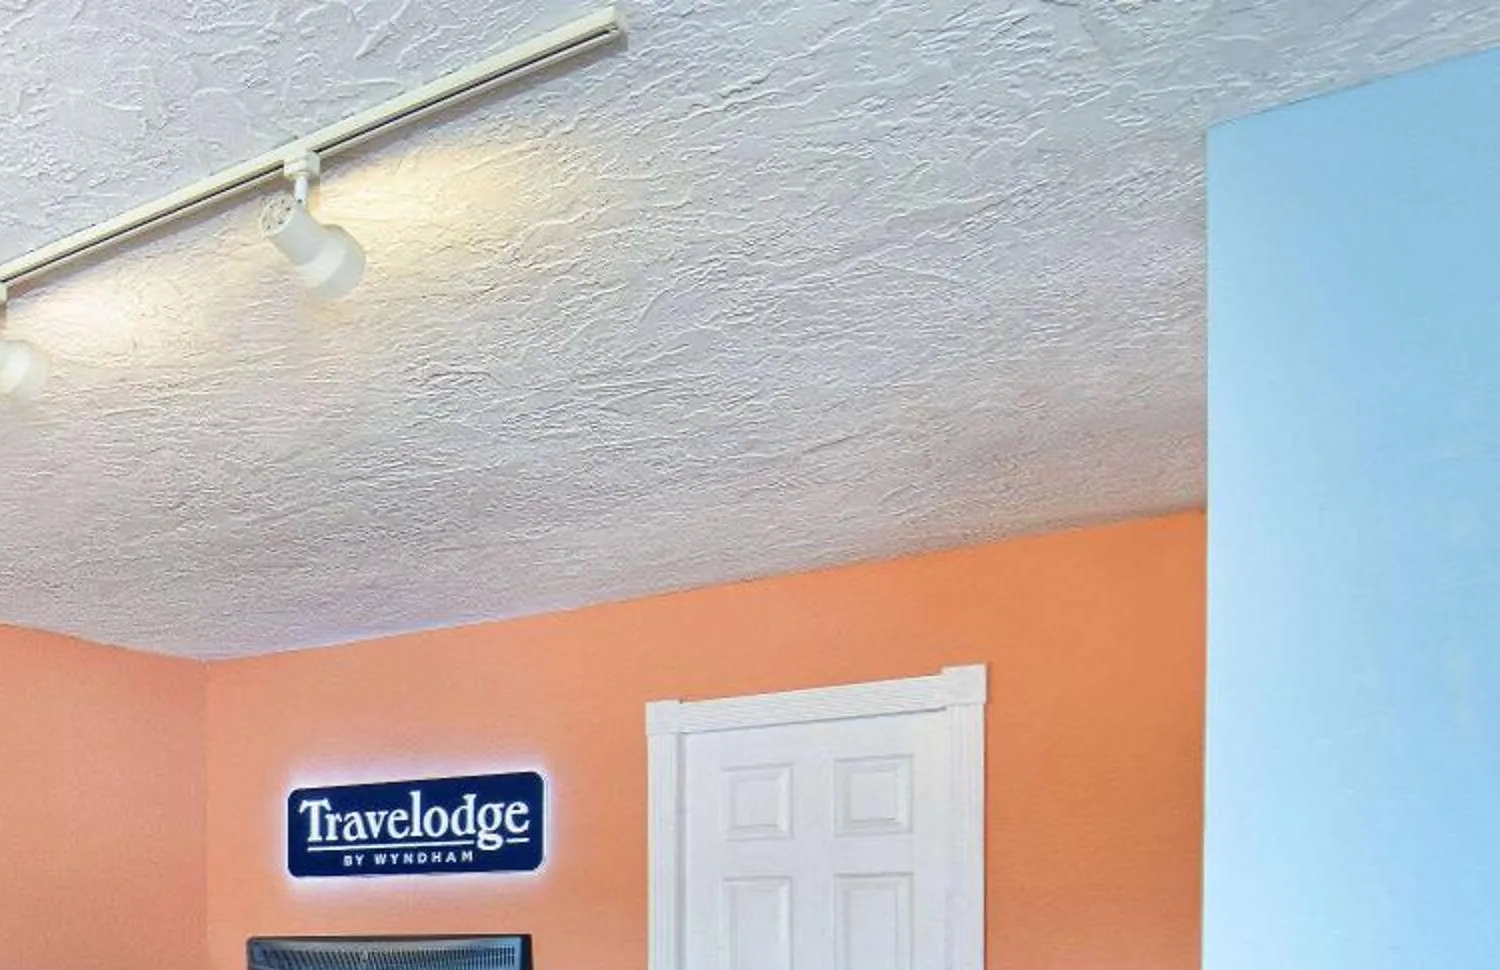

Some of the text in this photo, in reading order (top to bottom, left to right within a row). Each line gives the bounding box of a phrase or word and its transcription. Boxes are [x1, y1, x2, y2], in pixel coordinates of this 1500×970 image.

[299, 790, 530, 850] Travelodge
[343, 851, 473, 866] BY WYNDHAM
